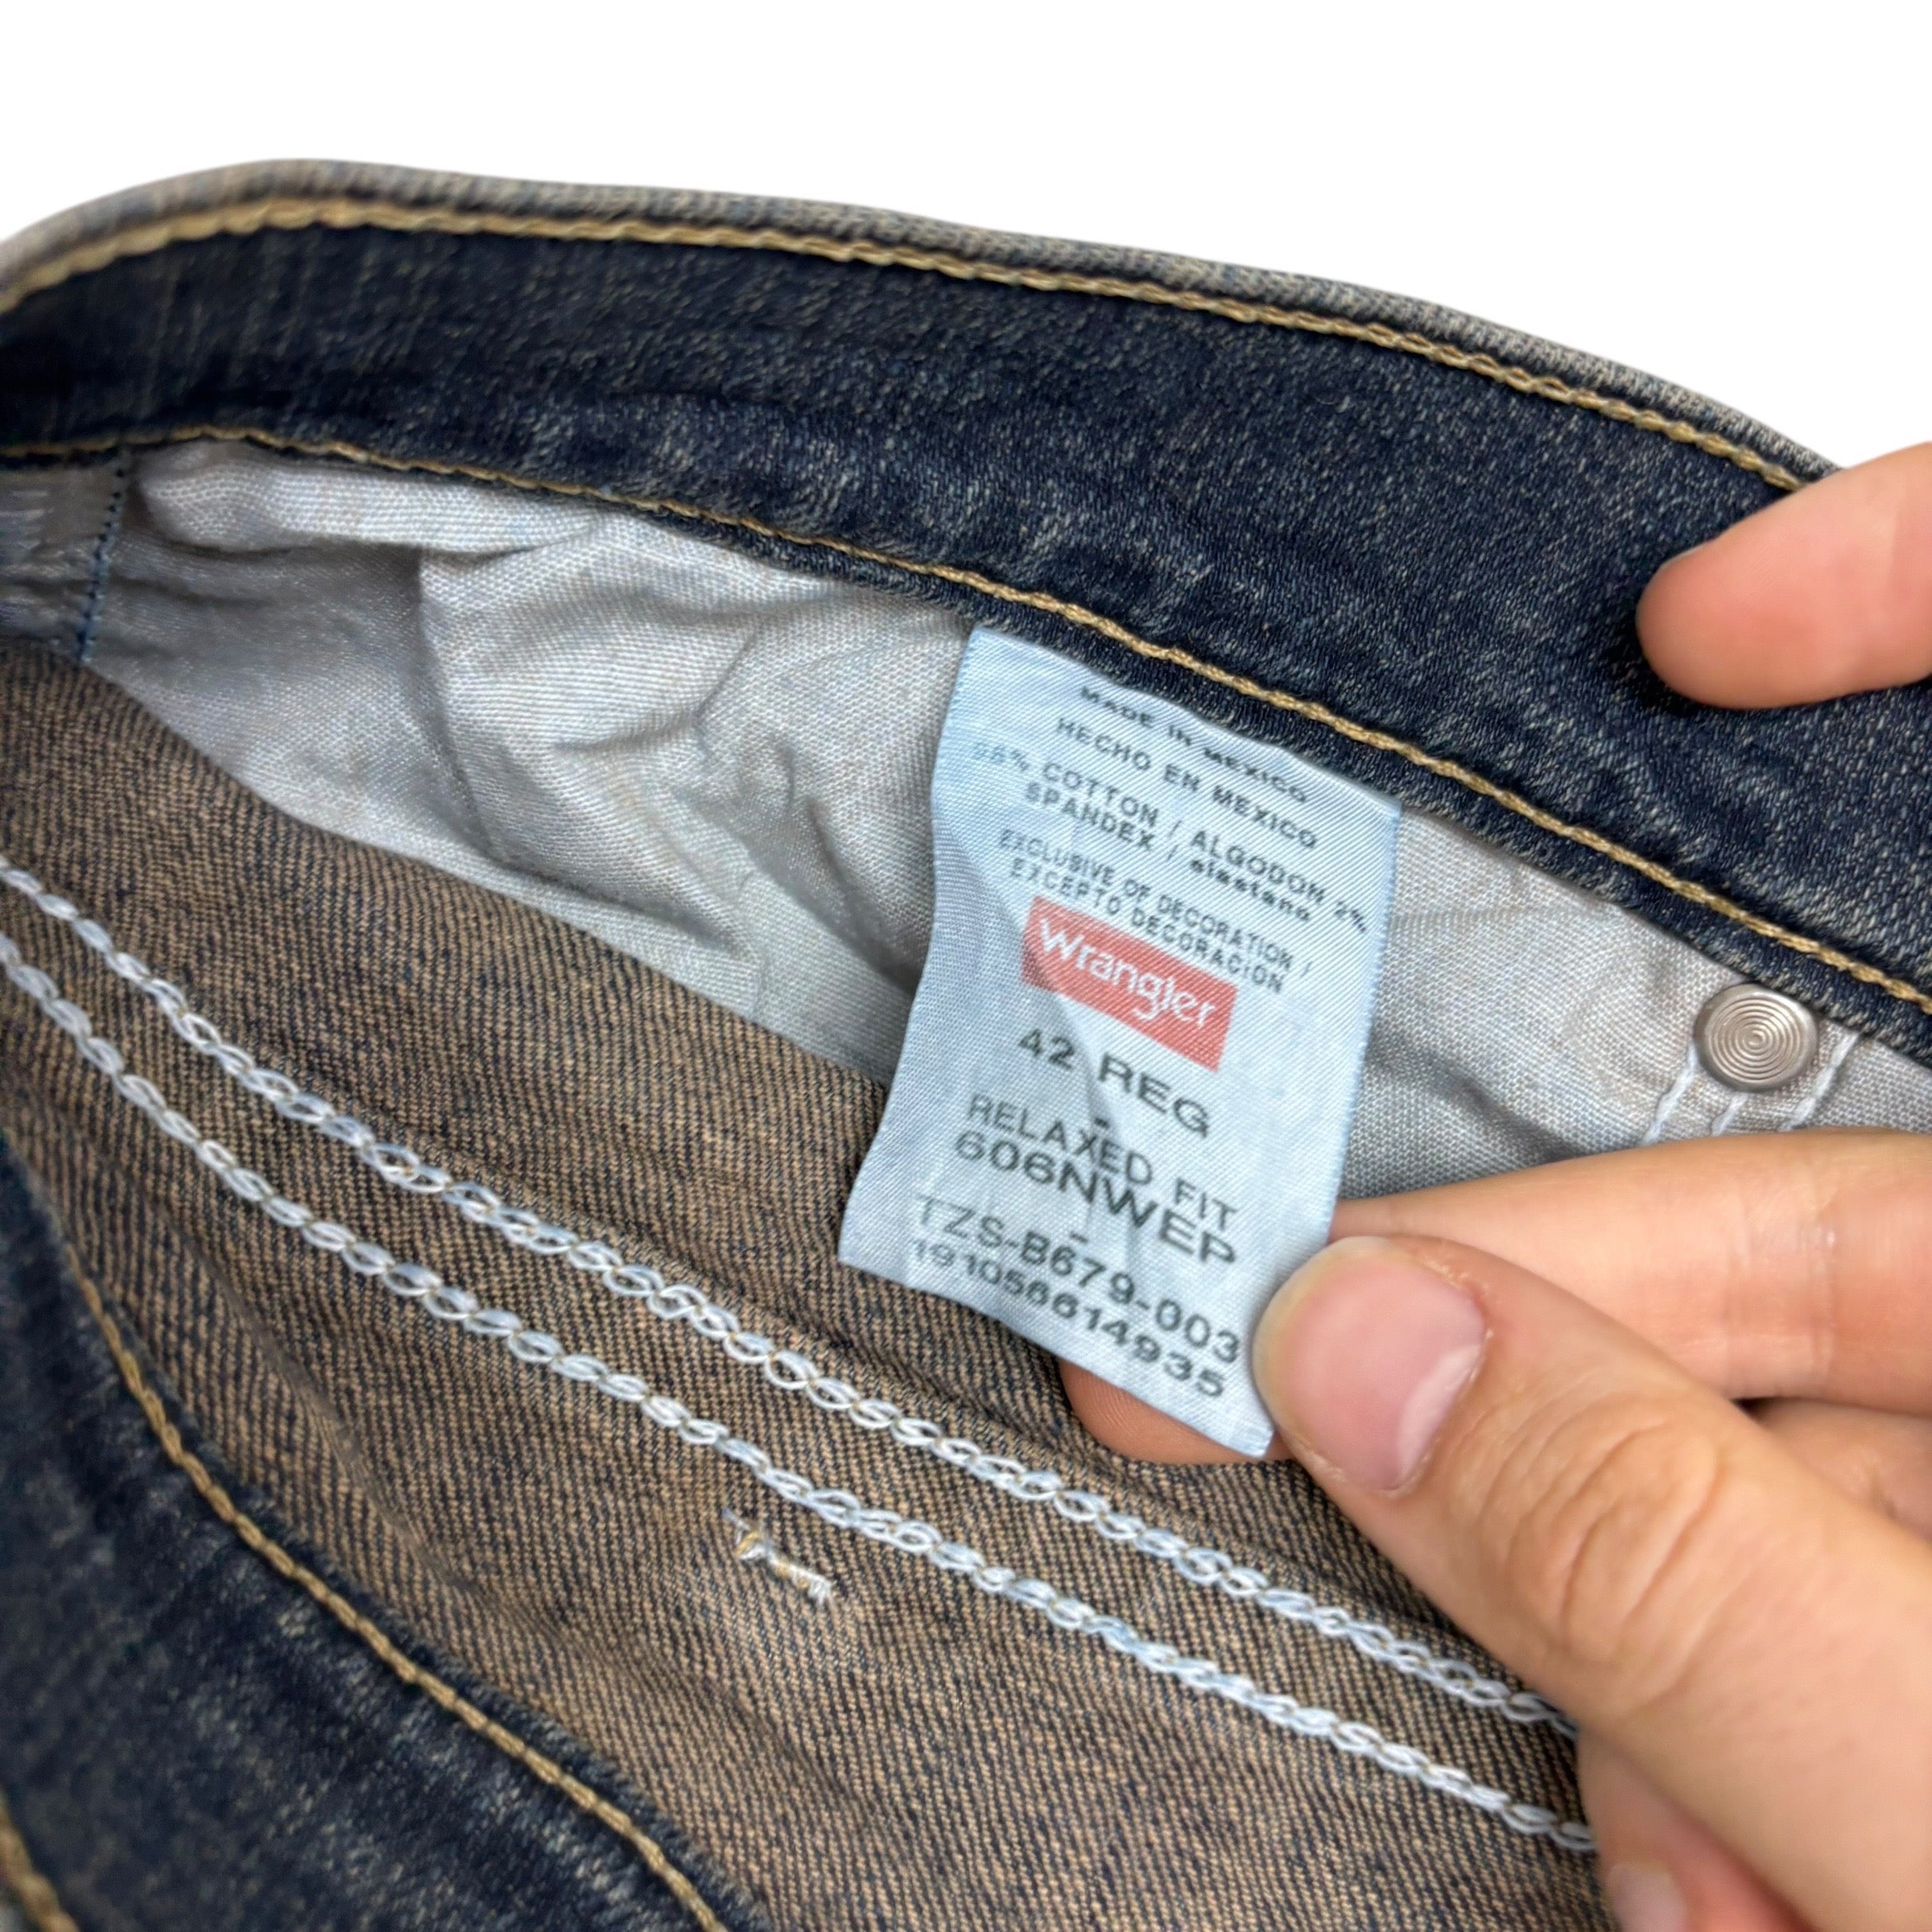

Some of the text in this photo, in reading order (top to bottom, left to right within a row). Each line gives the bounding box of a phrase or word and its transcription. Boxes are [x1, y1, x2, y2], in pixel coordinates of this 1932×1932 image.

[1057, 718, 1317, 848] HECHO EN MEXICO
[1081, 686, 1307, 803] MADE IN MEXICO
[1025, 782, 1155, 851] SPANDEX
[1167, 844, 1179, 861] /
[1043, 762, 1159, 828] COTTON
[1169, 819, 1183, 837] /
[1191, 830, 1328, 904] ALGODON
[999, 828, 1115, 886] EXCLUSIVE
[1125, 878, 1151, 902] OF
[1158, 894, 1294, 970] DECORATION
[1011, 857, 1284, 993] EXCEPTO DECORACION
[1038, 917, 1218, 1028] Wrangler
[1018, 1028, 1210, 1138] 42 REG
[954, 1129, 1236, 1263] 606NWEP
[966, 1093, 1237, 1231] RELAXED FIT
[914, 1194, 1240, 1364] TZS-B679-003
